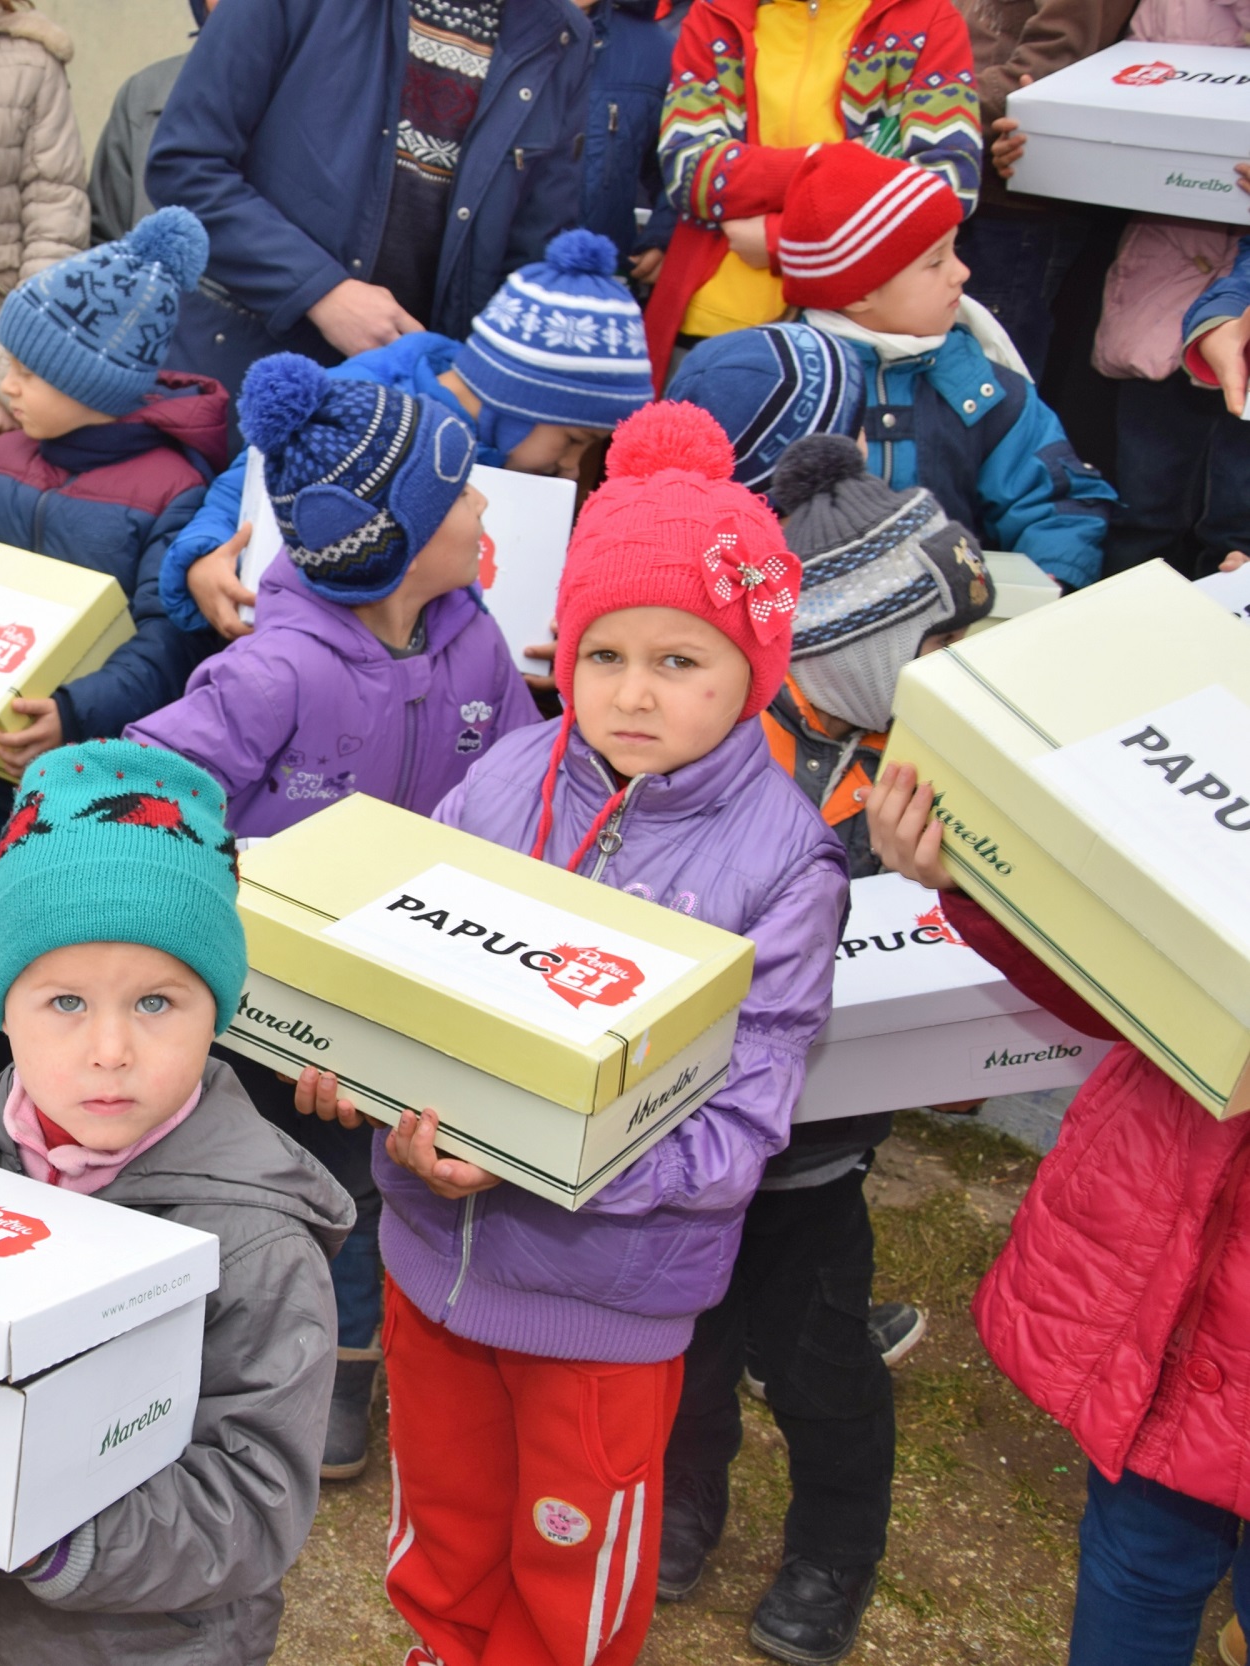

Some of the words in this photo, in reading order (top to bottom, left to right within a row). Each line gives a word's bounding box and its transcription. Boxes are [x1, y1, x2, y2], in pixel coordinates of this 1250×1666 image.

[1166, 173, 1233, 193] Marelbo
[572, 946, 630, 980] Pentru
[983, 1045, 1082, 1069] Marelbo
[626, 1066, 699, 1134] Marelbo
[102, 1273, 191, 1319] www.marelbo.com
[99, 1397, 172, 1456] Marelbo
